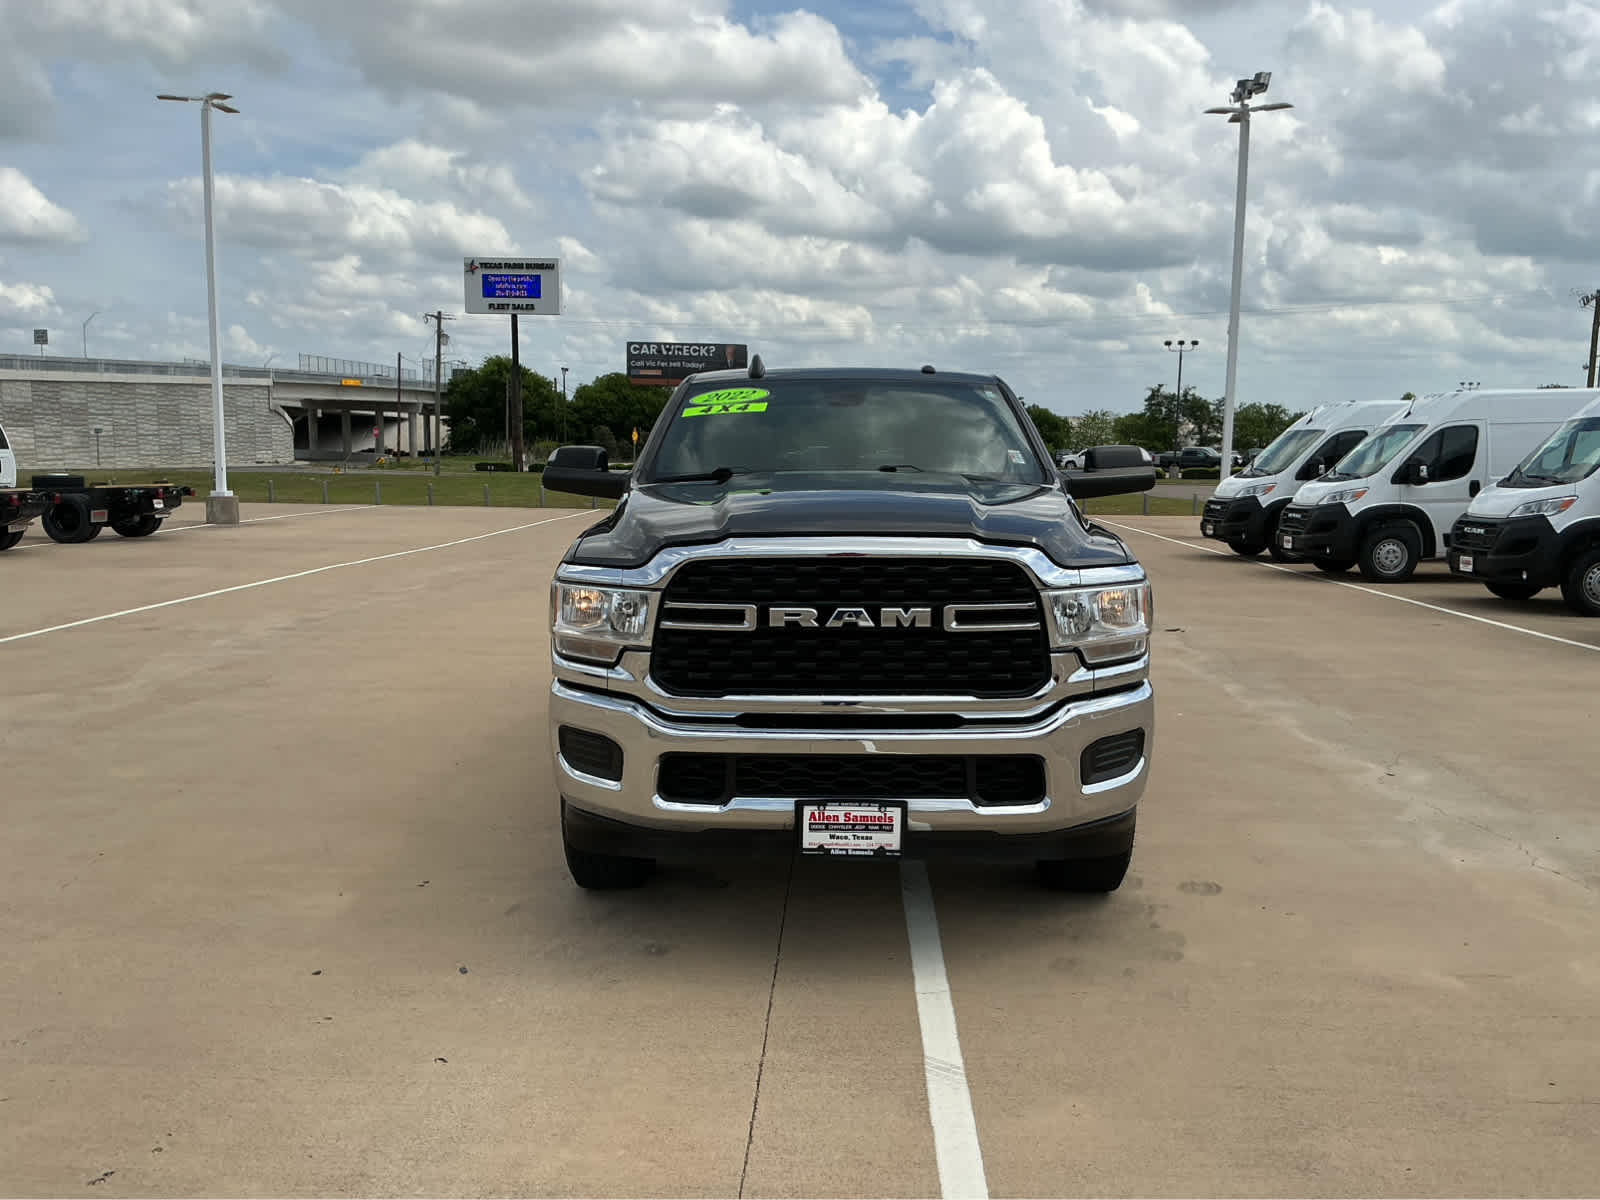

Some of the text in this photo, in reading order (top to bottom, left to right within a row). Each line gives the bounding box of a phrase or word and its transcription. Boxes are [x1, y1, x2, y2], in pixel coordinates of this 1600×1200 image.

[479, 262, 503, 270] TEXAS
[525, 263, 555, 271] BUREAU
[630, 344, 716, 357] CAR WRECK?
[630, 360, 645, 368] Call
[682, 361, 705, 370] Today!
[703, 390, 757, 402] 2022
[769, 607, 932, 627] RAM
[808, 811, 894, 823] Allen Samuels
[828, 833, 851, 841] Waco,
